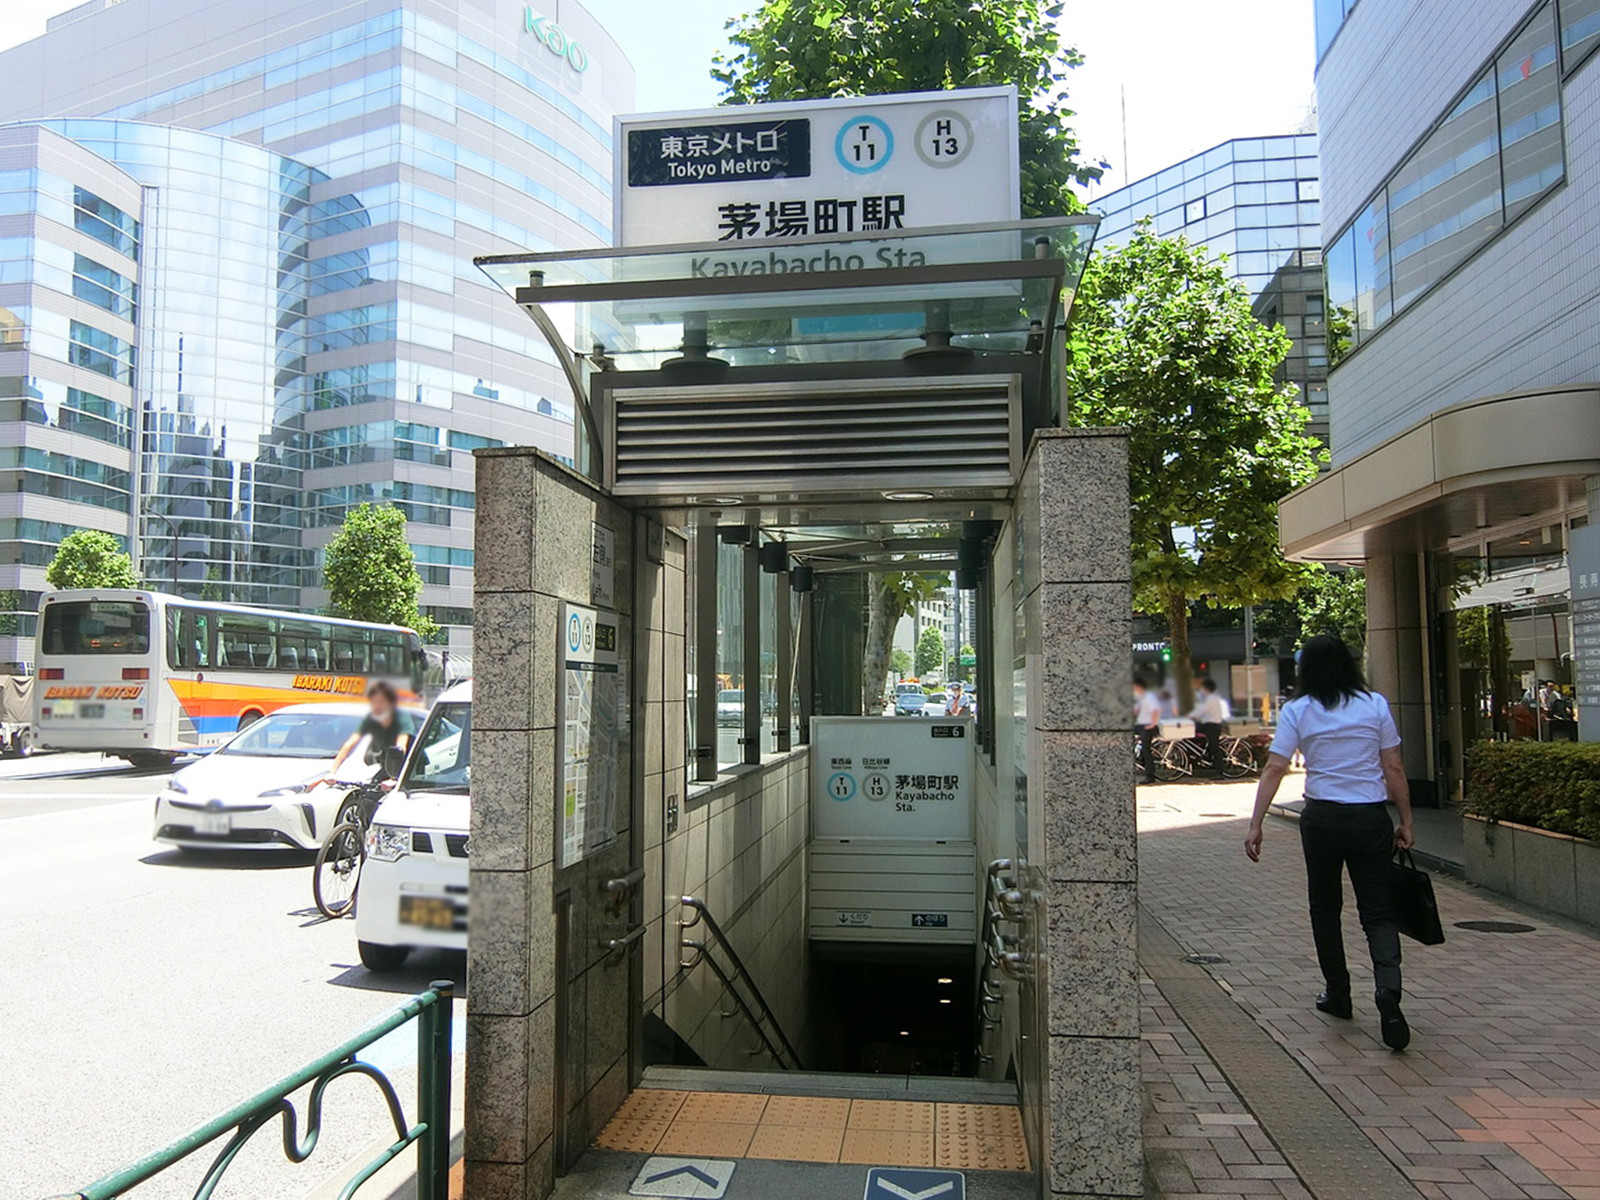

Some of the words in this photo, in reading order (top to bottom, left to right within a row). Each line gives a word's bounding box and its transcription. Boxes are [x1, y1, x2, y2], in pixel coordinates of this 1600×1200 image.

[859, 126, 870, 141] T
[937, 120, 951, 136] H
[660, 130, 778, 159] 東京メトロ
[932, 138, 959, 156] 13
[853, 144, 876, 161] 11
[668, 160, 716, 179] Tokyo
[721, 158, 771, 176] Metro
[718, 194, 905, 241] 茅場町駅
[292, 674, 333, 692] IBARAKI
[44, 686, 96, 700] IBARAKI
[96, 686, 143, 700] KOTSU
[952, 726, 960, 737] 6
[873, 777, 880, 785] H
[895, 775, 959, 790] 茅場町駅
[836, 786, 847, 795] 11
[871, 786, 884, 795] 13
[895, 791, 955, 803] Kayabacho
[895, 802, 916, 812] Sta.
